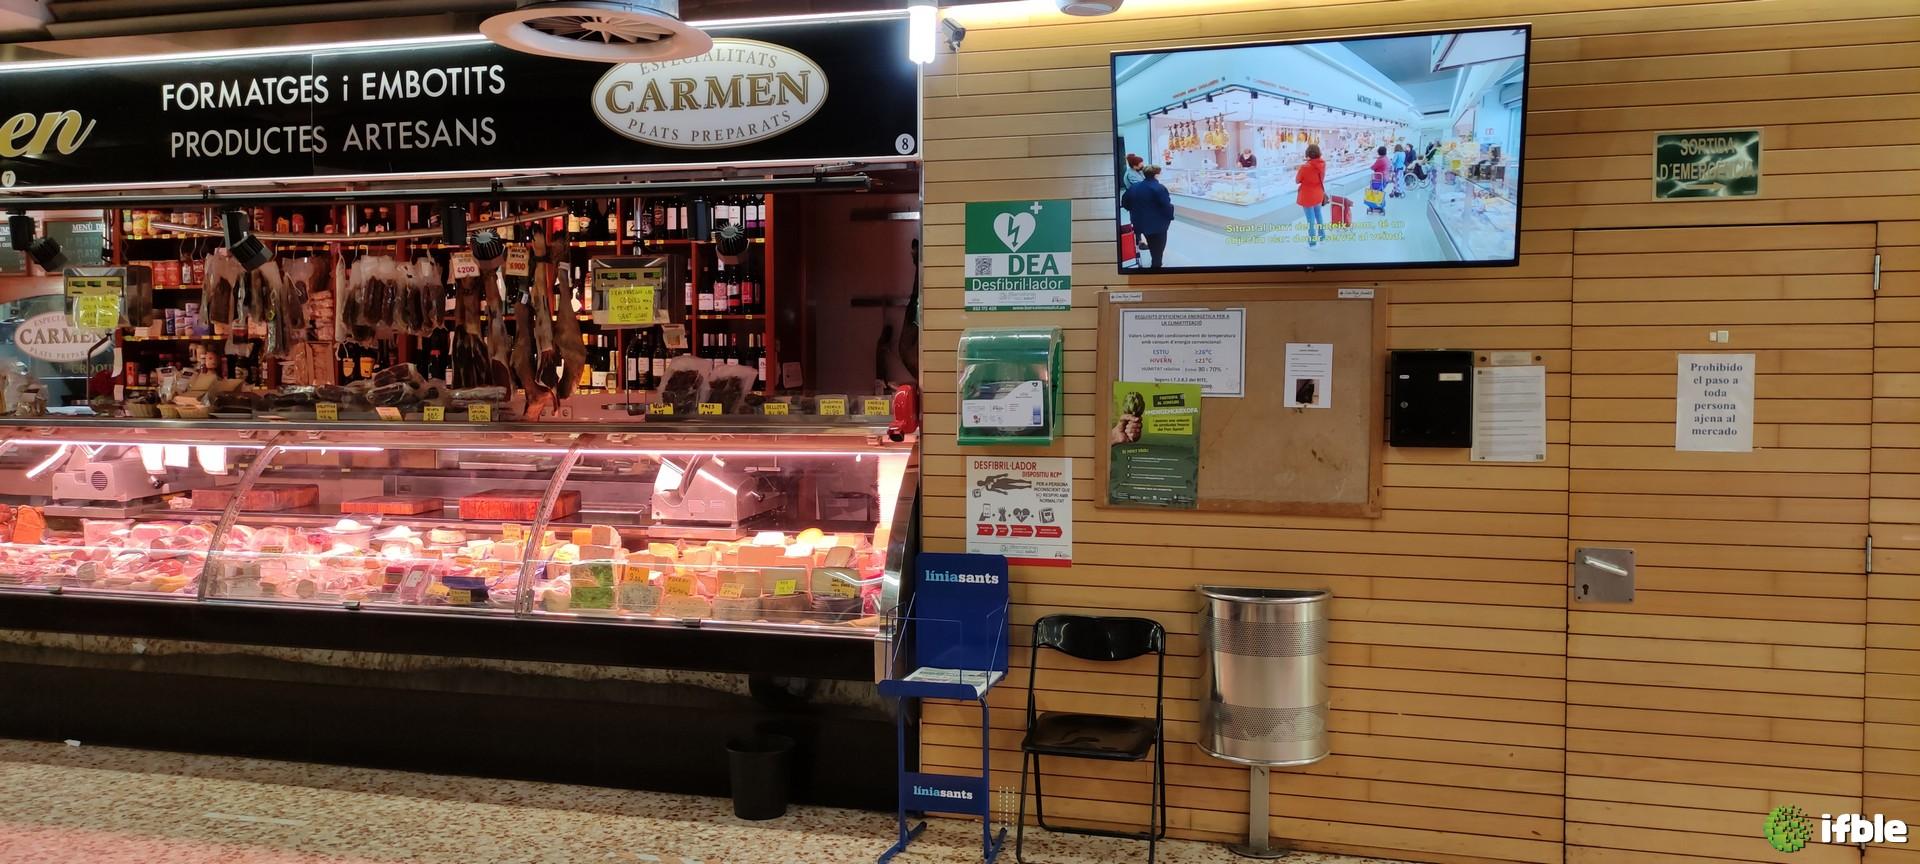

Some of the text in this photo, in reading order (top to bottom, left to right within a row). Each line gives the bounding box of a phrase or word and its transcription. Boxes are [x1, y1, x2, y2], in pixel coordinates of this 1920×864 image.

[163, 65, 506, 111] FORMATGES i EMBOTITS
[605, 71, 811, 114] CARMEN
[628, 111, 791, 142] PLATS PREPARATS
[171, 117, 497, 158] PRODUCTES ARTESANS
[902, 137, 908, 150] 8
[1680, 137, 1735, 156] SORTIDA
[6, 173, 11, 184] 7
[72, 222, 93, 231] MENÚ
[1226, 224, 1255, 233] Situat
[1257, 223, 1266, 232] al
[1315, 222, 1346, 231] mateix
[1008, 254, 1059, 275] DEA
[972, 278, 1063, 291] Desfibril·lador
[1691, 363, 1743, 372] Prohibido
[1693, 376, 1702, 384] el
[1705, 377, 1730, 386] paso
[1704, 389, 1727, 397] toda
[1694, 402, 1736, 411] persona
[1694, 413, 1736, 424] ajena al
[1692, 427, 1737, 436] mercado
[974, 460, 1037, 471] DESFIBRIL·LADOR
[925, 570, 999, 584] líniasants
[913, 785, 973, 800] líniasants
